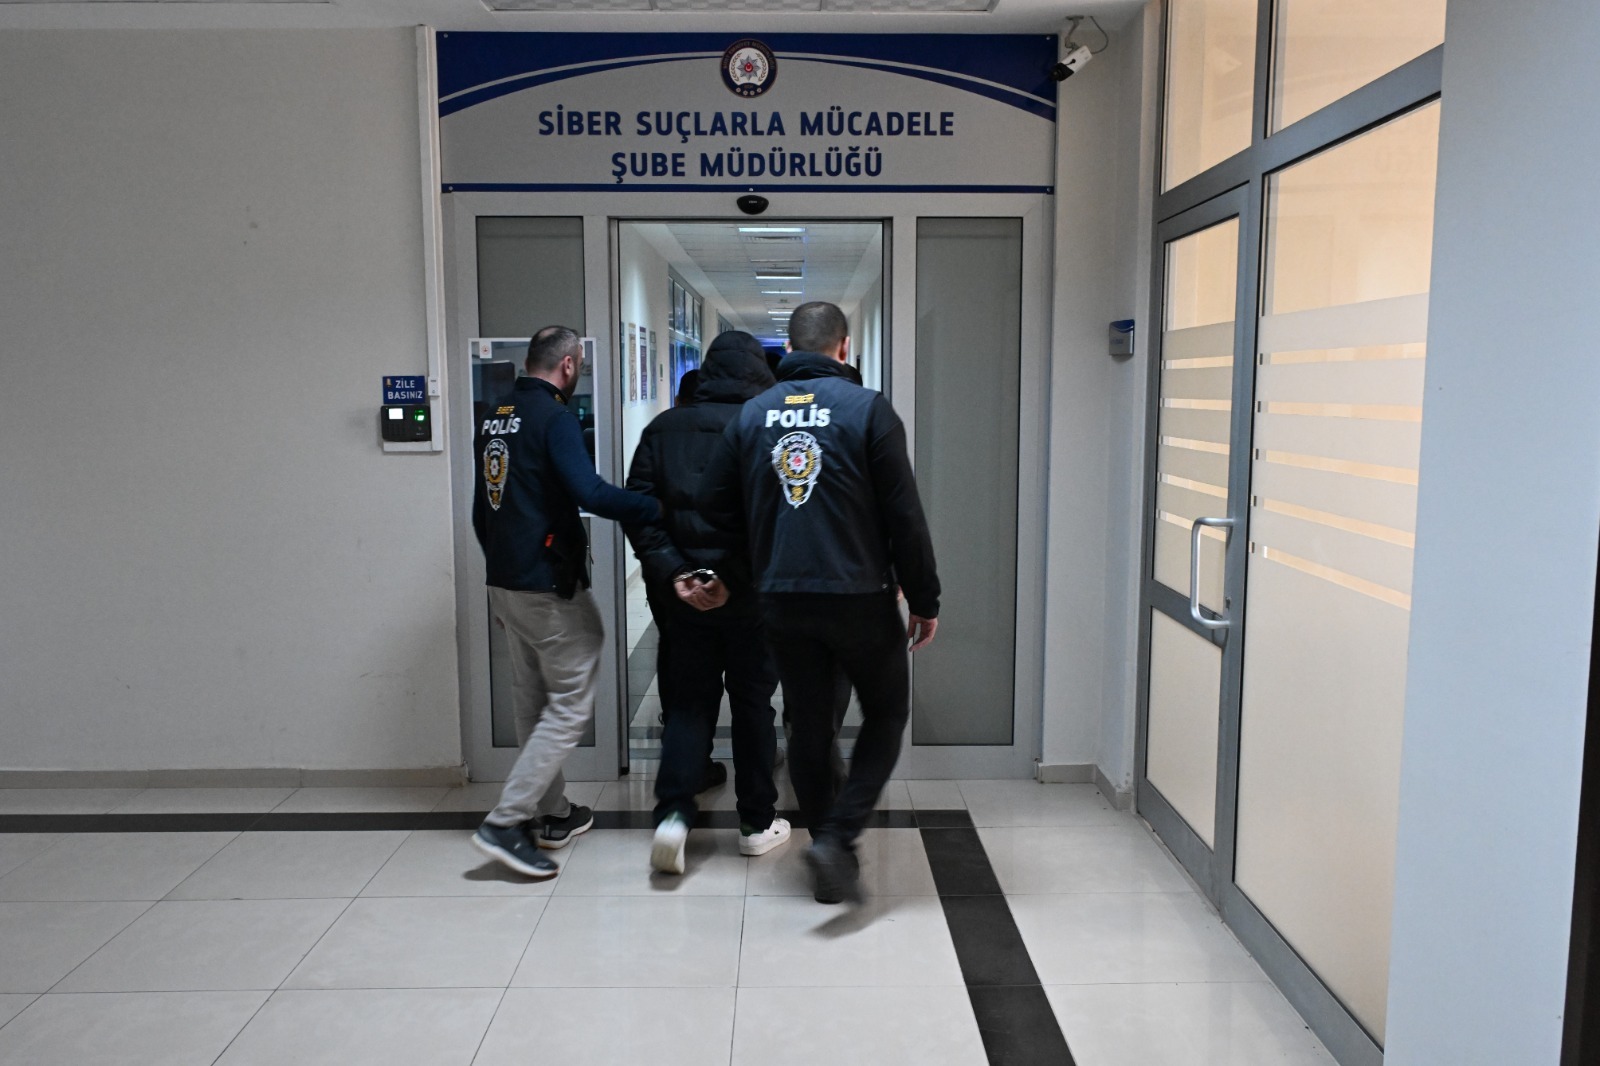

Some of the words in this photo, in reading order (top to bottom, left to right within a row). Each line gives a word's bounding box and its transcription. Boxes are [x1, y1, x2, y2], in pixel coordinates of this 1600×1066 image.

[538, 104, 622, 136] SİBER
[636, 111, 786, 143] SUÇLARLA
[800, 105, 954, 136] MÜCADELE
[611, 152, 686, 184] ŞUBE
[700, 146, 882, 177] MÜDÜRLÜĞÜ
[395, 378, 415, 389] ZİLE
[387, 391, 423, 400] BASINIZ
[481, 414, 522, 435] POLİS
[765, 403, 831, 428] POLİS
